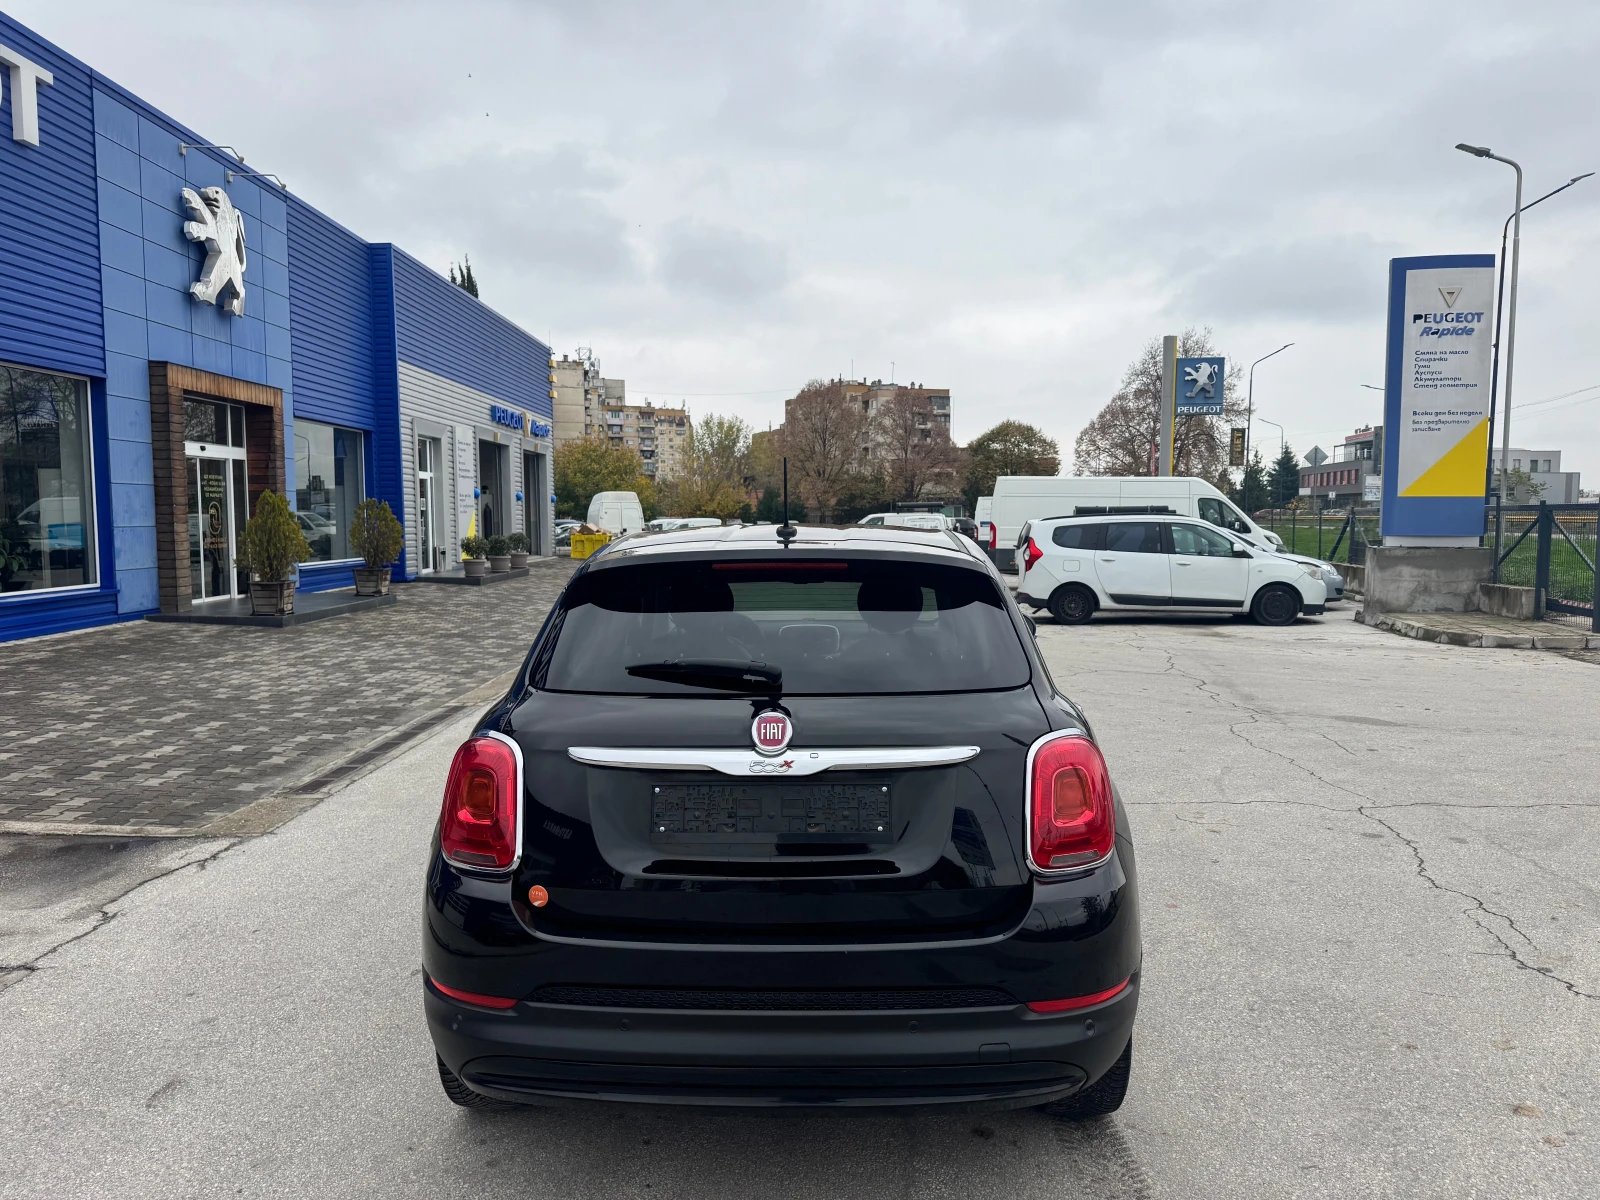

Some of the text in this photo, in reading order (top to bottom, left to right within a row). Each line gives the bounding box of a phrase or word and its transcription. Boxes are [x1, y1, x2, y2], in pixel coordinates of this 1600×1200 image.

[1413, 312, 1484, 324] PEUGEOT
[1420, 325, 1475, 338] Rapide
[1177, 405, 1222, 413] PEUGEOT
[760, 723, 784, 740] FIAT
